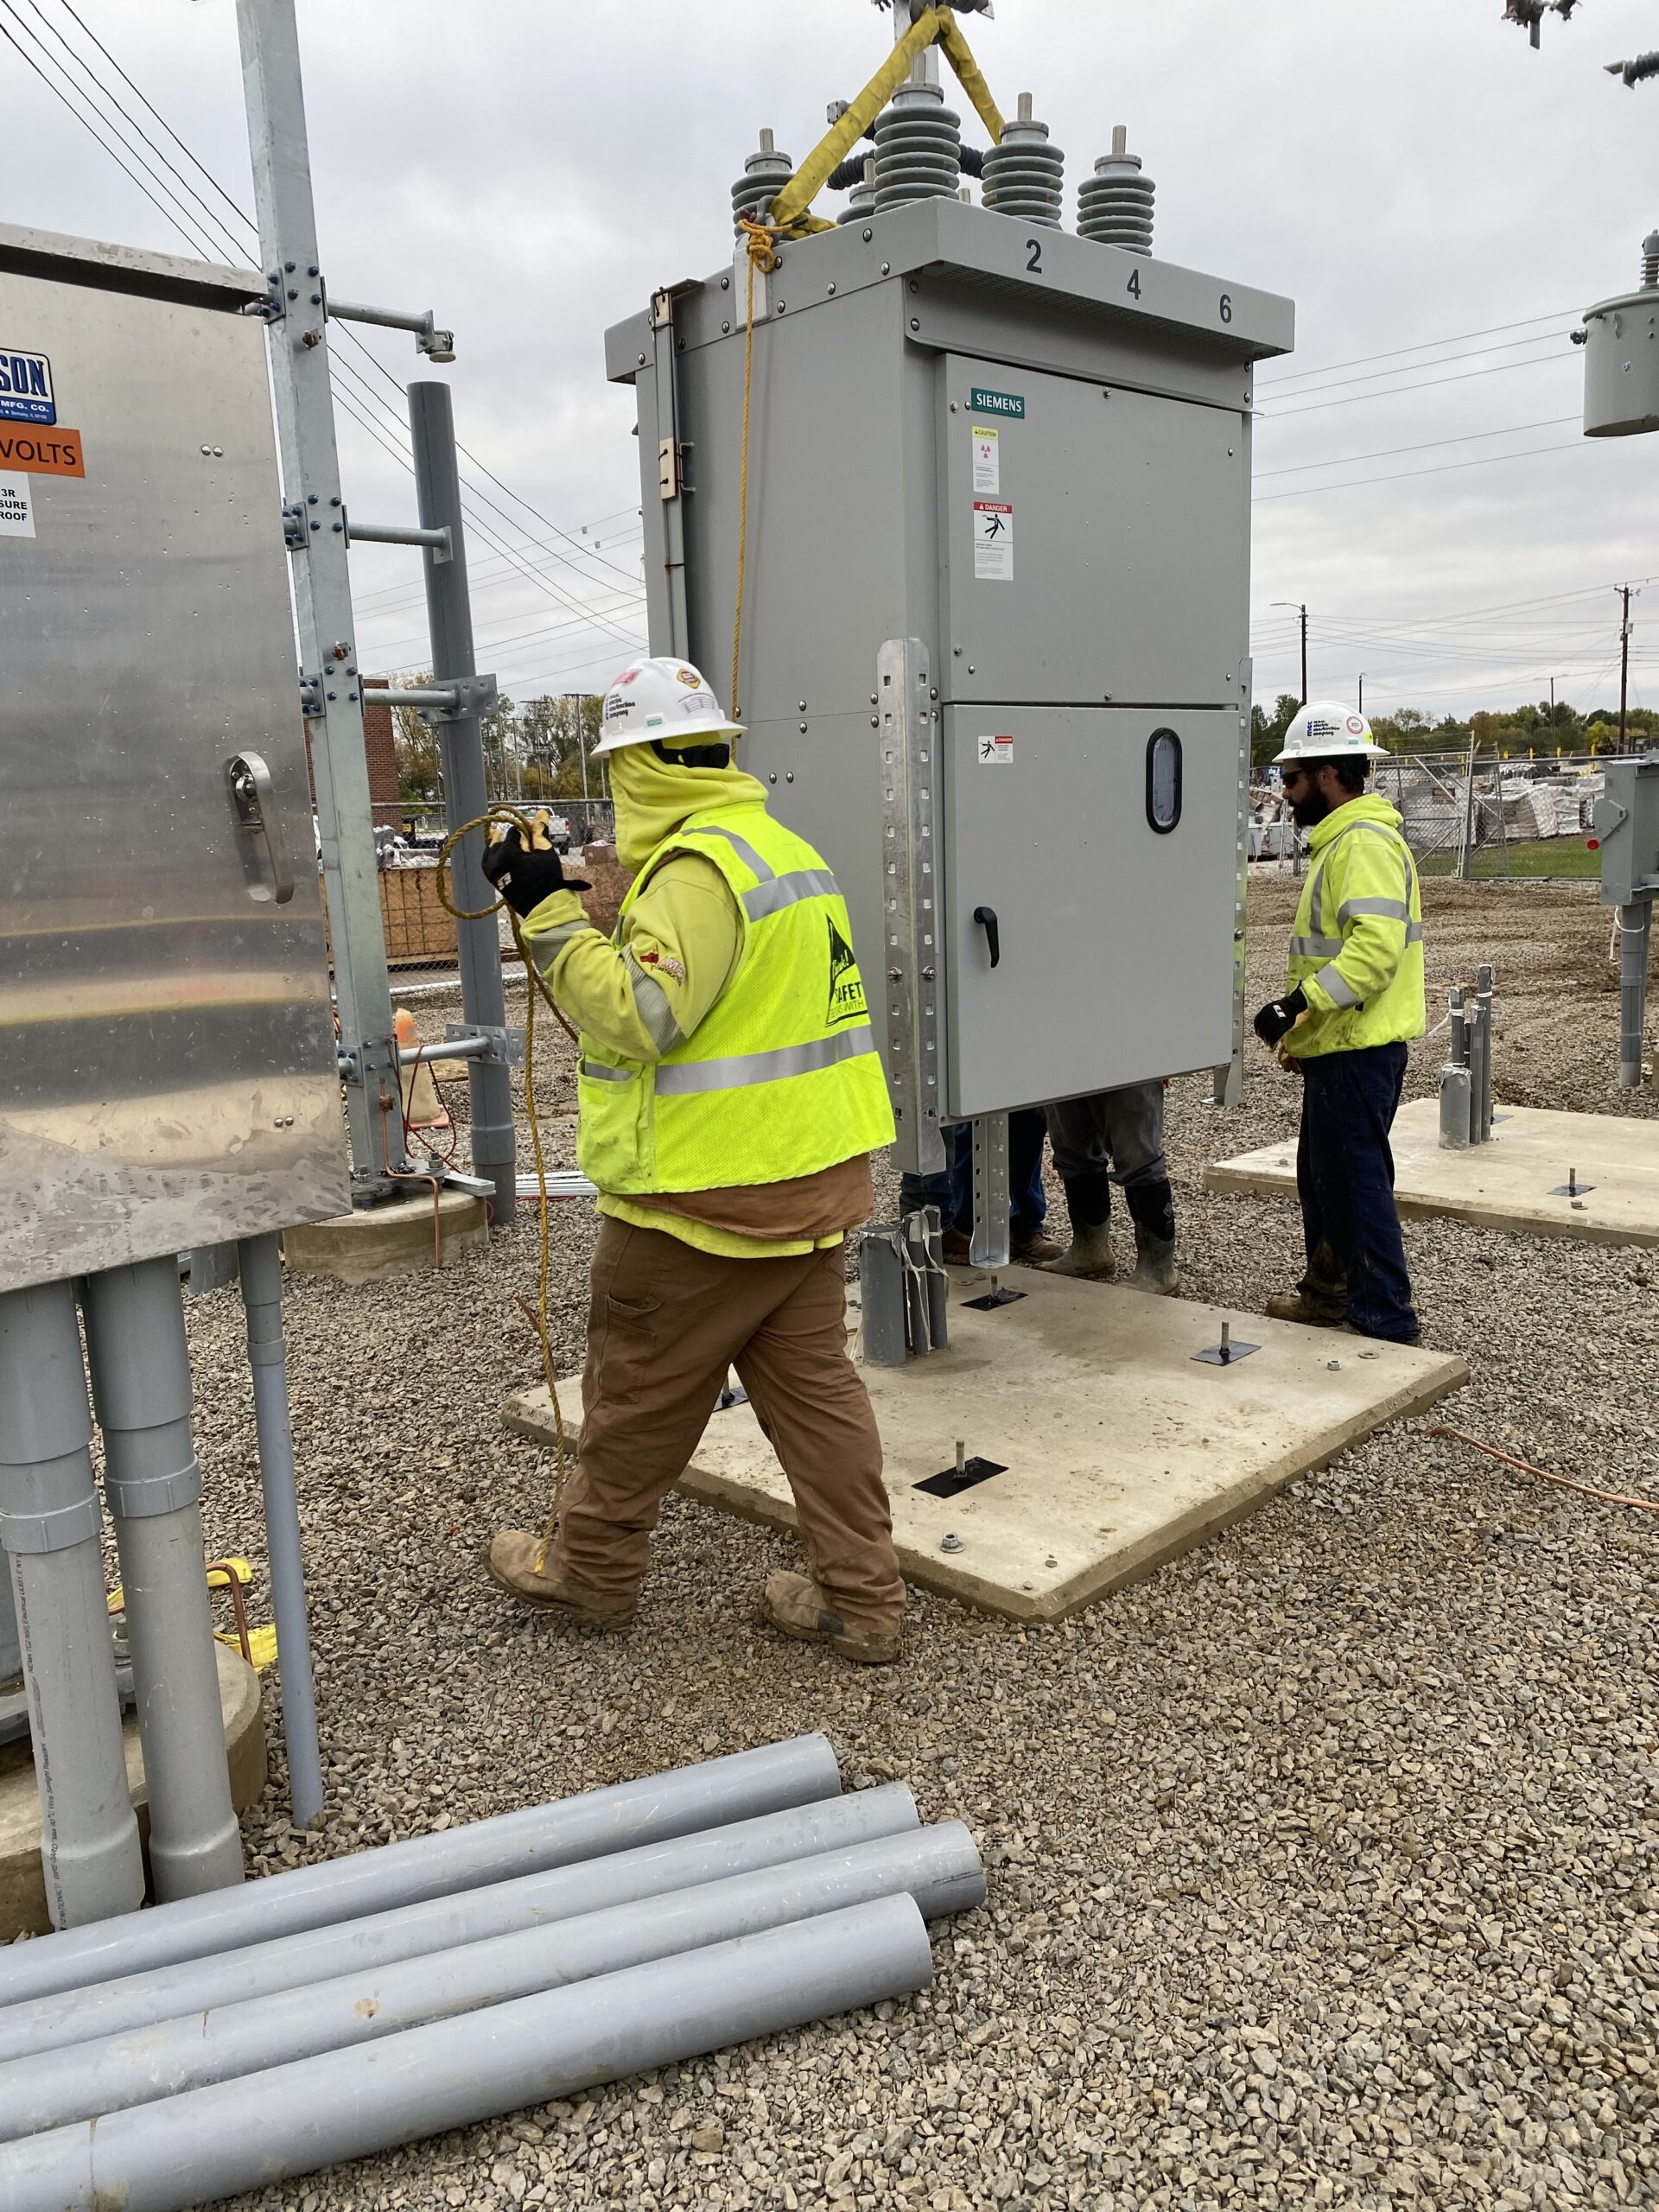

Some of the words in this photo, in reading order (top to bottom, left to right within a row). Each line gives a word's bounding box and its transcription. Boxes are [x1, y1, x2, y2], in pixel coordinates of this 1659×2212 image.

[1026, 238, 1042, 274] 2
[1127, 269, 1141, 300] 4
[1219, 294, 1232, 324] 6
[0, 400, 28, 410] MFG.
[30, 404, 49, 413] CO.
[976, 393, 1022, 412] SIEMENS
[0, 439, 76, 466] VOLTS
[1, 488, 16, 498] 3R
[984, 504, 1007, 512] DANGER
[835, 981, 861, 1003] SAFET
